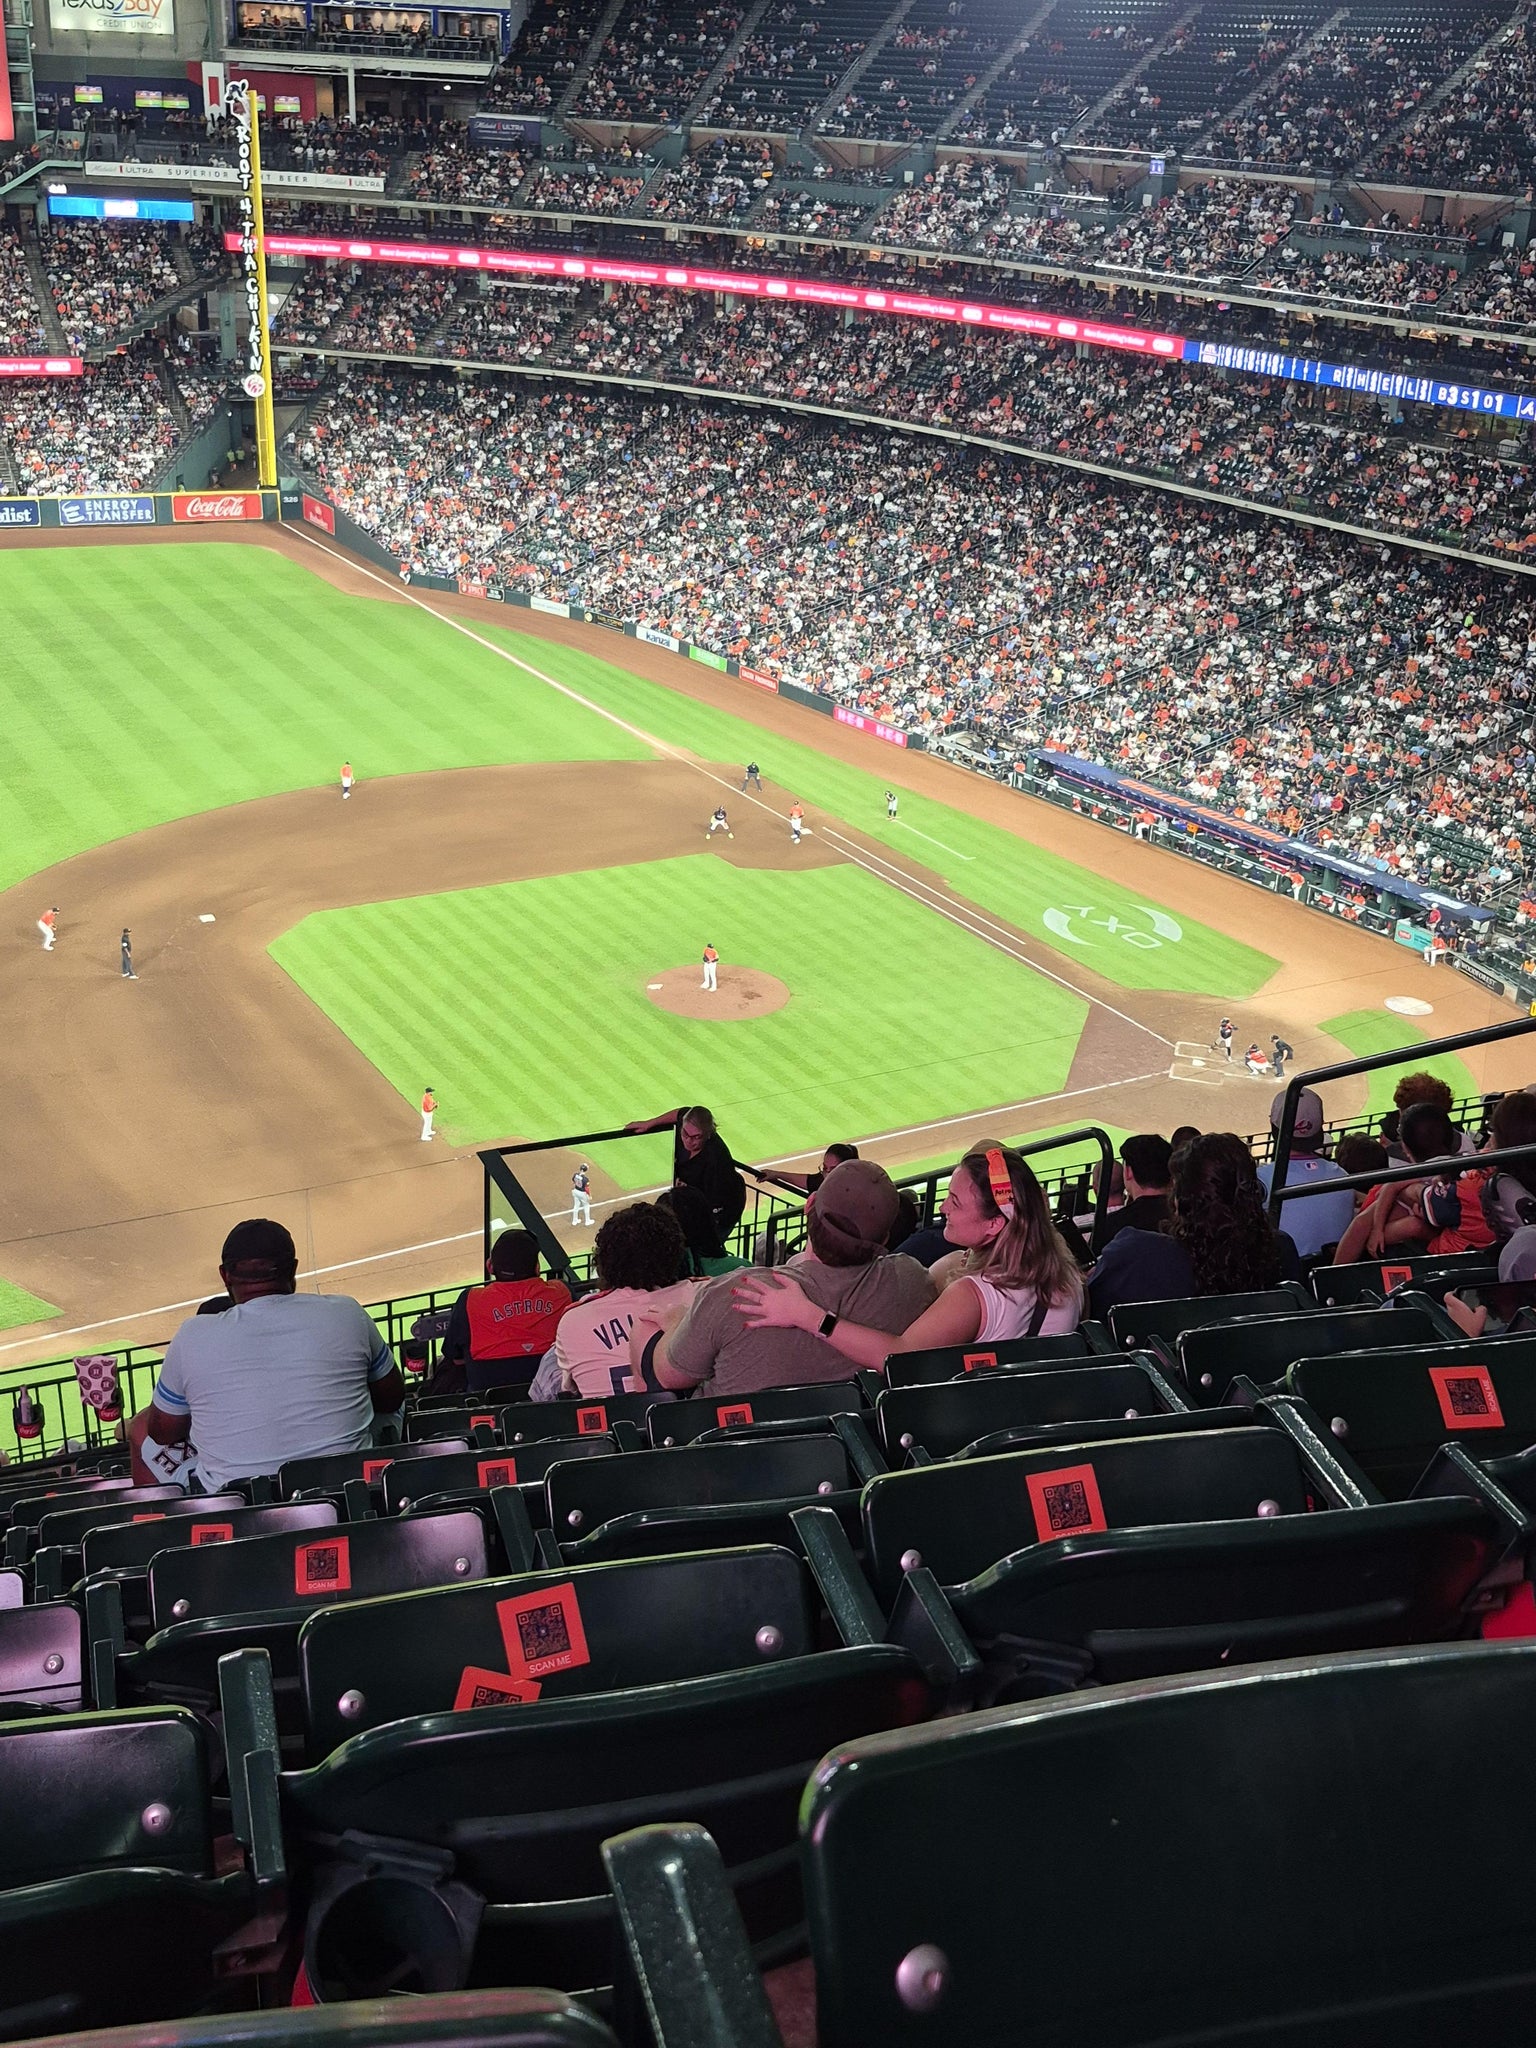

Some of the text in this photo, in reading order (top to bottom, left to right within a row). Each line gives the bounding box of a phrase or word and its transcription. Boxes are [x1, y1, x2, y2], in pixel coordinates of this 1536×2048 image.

[97, 19, 162, 29] CREDIT UNION
[502, 123, 525, 131] ULTRA
[236, 125, 253, 191] ROOT
[125, 166, 154, 174] ULTRA
[167, 169, 229, 178] SUPERIOR
[279, 174, 308, 182] BEER
[354, 180, 381, 188] ULTRA
[240, 197, 252, 215] 4
[241, 221, 258, 272] THA
[245, 277, 263, 371] CHIKIN
[1333, 369, 1415, 395] R H E L
[85, 499, 138, 511] ENERGY
[186, 496, 247, 518] Coca-Cola
[87, 509, 153, 521] TRANSFER
[492, 1299, 554, 1323] ASTROS
[308, 1580, 337, 1590] SCAN ME
[529, 1654, 572, 1674] SCAN ME
